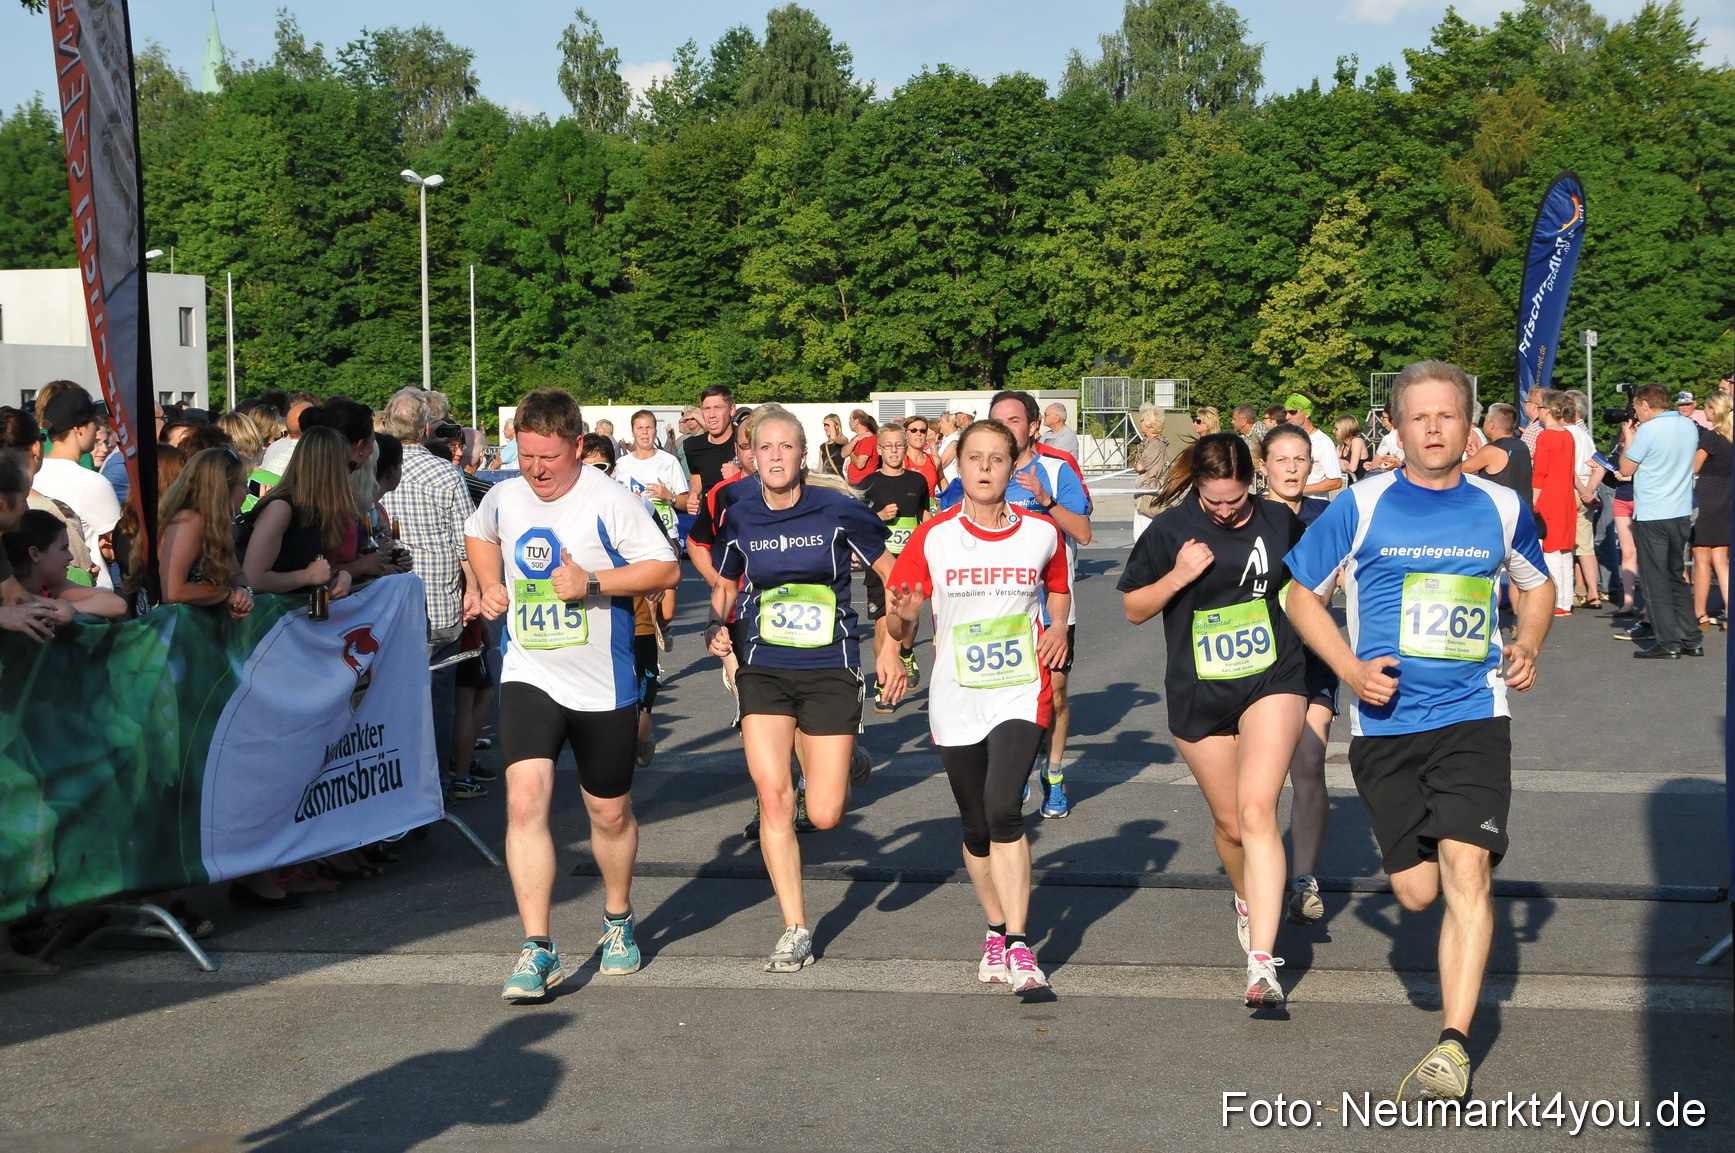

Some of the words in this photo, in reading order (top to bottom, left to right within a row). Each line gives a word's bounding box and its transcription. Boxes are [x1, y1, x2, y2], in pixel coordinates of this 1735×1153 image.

[526, 546, 550, 559] TÜV
[750, 539, 779, 552] EURO
[789, 535, 824, 548] POLES
[1380, 545, 1490, 559] energiegeladen
[531, 561, 544, 569] SÜD
[945, 567, 1038, 586] PFEIFFER
[517, 603, 583, 631] 1415
[771, 602, 822, 632] 323
[1405, 602, 1486, 641] 1262
[966, 639, 1023, 673] 955
[1197, 626, 1271, 662] 1059
[294, 752, 404, 824] Lammsbräu
